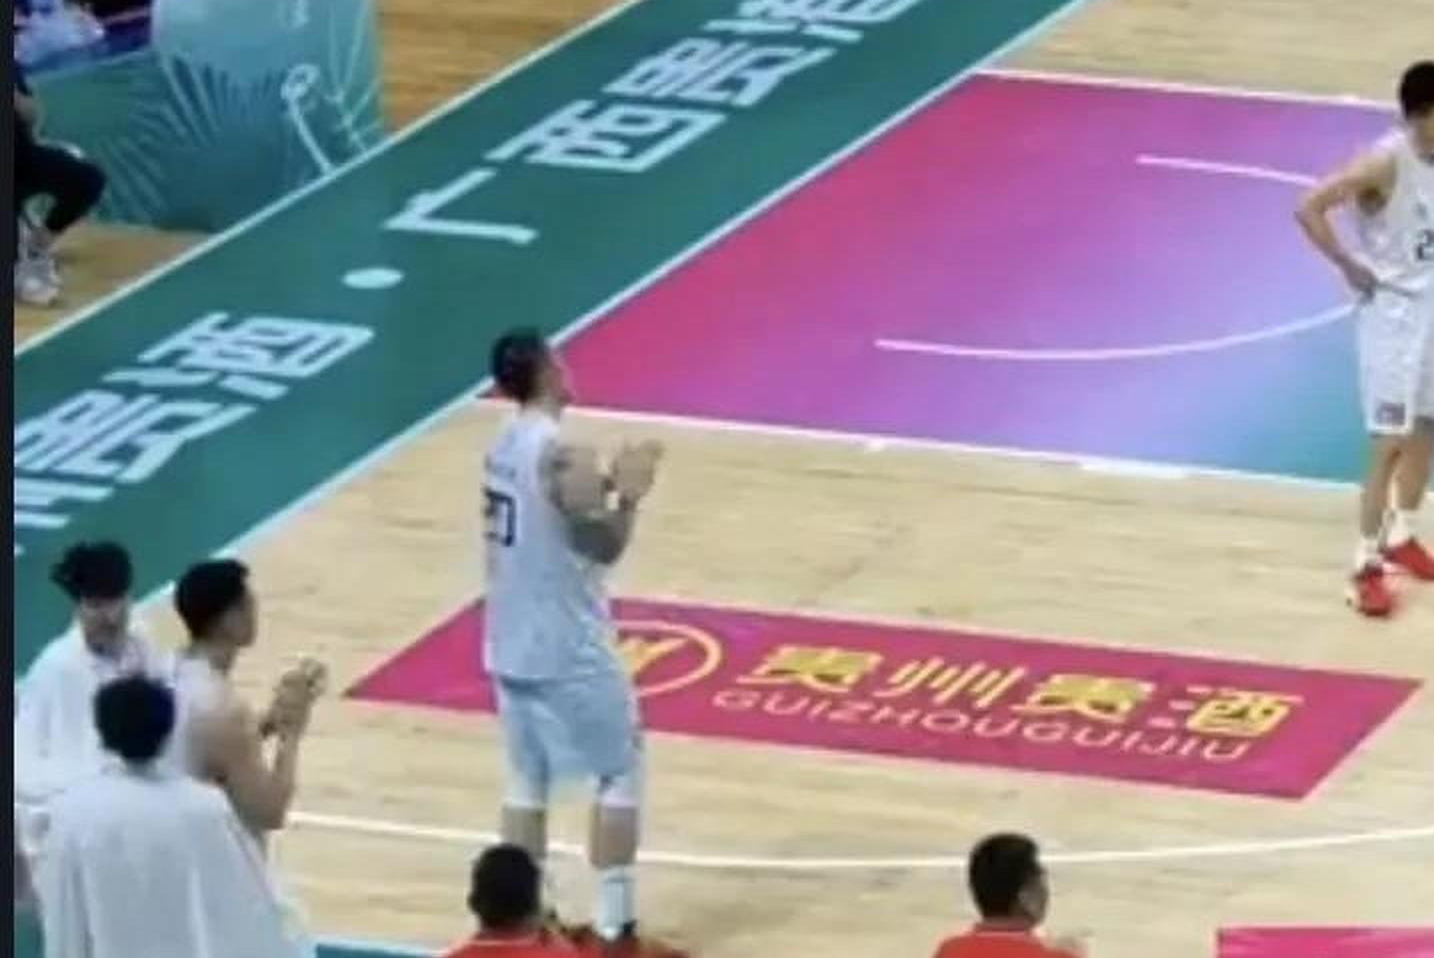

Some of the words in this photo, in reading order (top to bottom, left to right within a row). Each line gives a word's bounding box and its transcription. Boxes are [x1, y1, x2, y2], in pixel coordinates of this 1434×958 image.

[712, 689, 1250, 762] GUIZHOUGUIJIU
[736, 644, 1302, 739] 贵州贵酒
